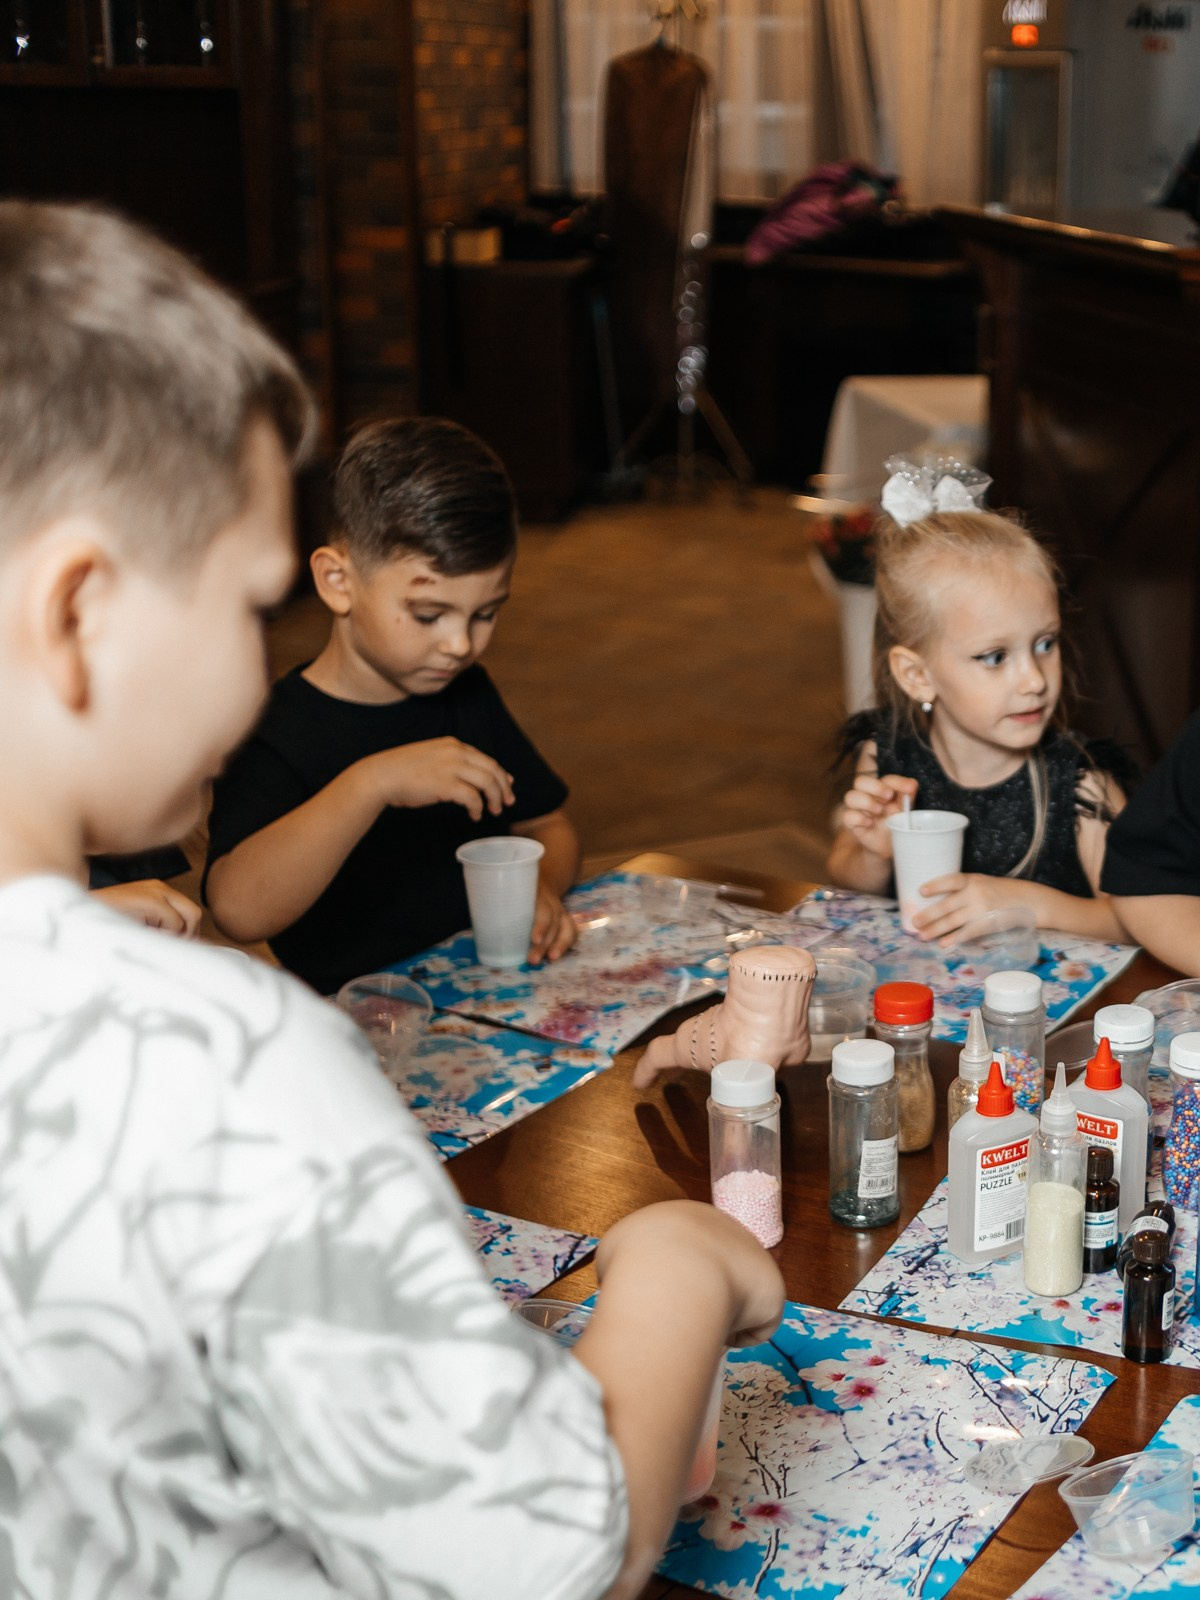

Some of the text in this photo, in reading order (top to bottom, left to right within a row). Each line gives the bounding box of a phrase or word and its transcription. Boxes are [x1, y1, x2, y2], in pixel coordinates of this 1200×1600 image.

[1077, 1116, 1114, 1135] WELT
[982, 1143, 1028, 1165] KWELT
[998, 1165, 1010, 1173] для
[1011, 1159, 1028, 1168] пазло
[980, 1176, 1013, 1191] PUZZLE
